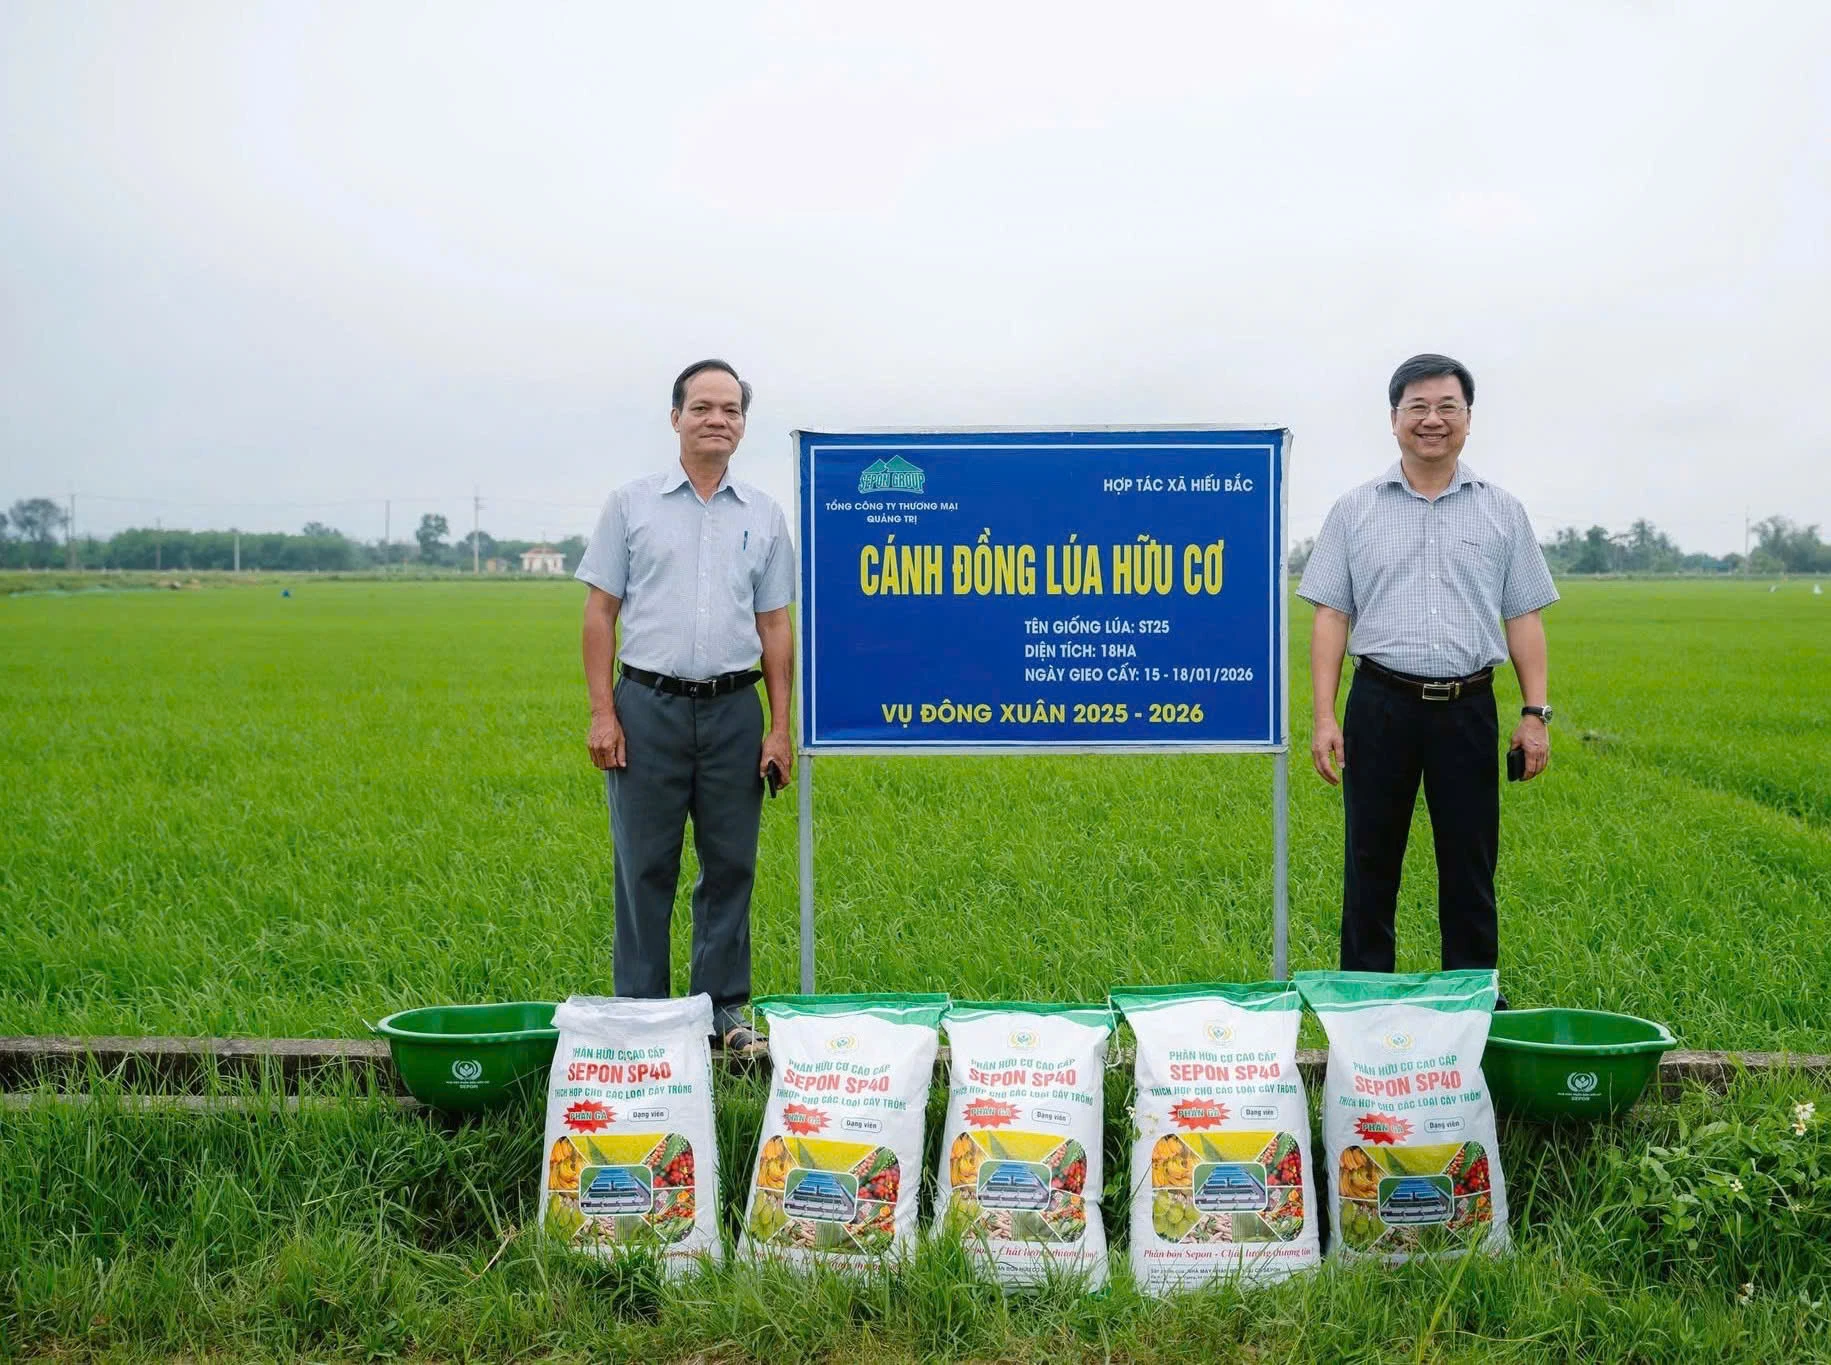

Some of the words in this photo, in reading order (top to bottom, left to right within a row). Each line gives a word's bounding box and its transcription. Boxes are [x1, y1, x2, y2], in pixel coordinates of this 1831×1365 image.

[858, 472, 891, 490] SEPON
[891, 472, 925, 489] GROUP
[1103, 476, 1133, 495] HỢP
[1136, 475, 1164, 492] TÁC
[1167, 476, 1187, 492] XÃ
[1191, 473, 1220, 492] HIẾU
[1224, 473, 1254, 492] BẮC
[825, 499, 852, 510] TỔNG
[855, 500, 884, 510] CÔNG
[886, 502, 896, 510] TY
[899, 502, 938, 510] THƯƠNG
[940, 502, 958, 512] MẠI
[866, 513, 902, 523] QUẢNG
[904, 515, 918, 525] TRỊ
[860, 534, 943, 595] CÁNH
[952, 528, 1036, 595] ĐỒNG
[1046, 534, 1103, 595] LÚA
[1112, 534, 1173, 595] HỮU
[1183, 539, 1225, 595] CƠ
[1024, 617, 1048, 634] TÊN
[1053, 615, 1101, 634] GIỐNG
[1105, 616, 1135, 634] LÚA:
[1139, 620, 1170, 634] ST25
[1024, 640, 1056, 662] DIỆN
[1060, 641, 1096, 658] TÍCH:
[1101, 644, 1137, 658] 18HA
[1024, 665, 1064, 682] NGÀY
[1069, 668, 1103, 682] GIEO
[1106, 662, 1140, 682] CẤY:
[1144, 668, 1160, 682] 15
[1172, 667, 1254, 682] 18/01/2026
[880, 703, 913, 728] VỤ
[920, 698, 993, 723] ĐÔNG
[1000, 698, 1065, 723] XUÂN
[1073, 703, 1128, 723] 2025
[1148, 703, 1204, 723] 2026
[567, 1062, 623, 1084] SEPON
[627, 1061, 672, 1083] SP40
[1169, 1063, 1229, 1082] SEPON
[1235, 1063, 1280, 1081] SP40
[1417, 1059, 1435, 1070] CAO
[783, 1068, 840, 1092] SEPON
[845, 1075, 890, 1094] SP40
[968, 1067, 1026, 1087] SEPON
[1031, 1068, 1077, 1087] SP40
[1355, 1075, 1411, 1097] SEPON
[1415, 1070, 1462, 1092] SP40
[633, 1110, 649, 1119] Dạng
[1036, 1111, 1052, 1121] Dạng
[1246, 1108, 1261, 1117] Dạng
[846, 1120, 863, 1129] Dạng
[1429, 1121, 1445, 1130] Dạng
[1185, 1250, 1213, 1260] Sepon
